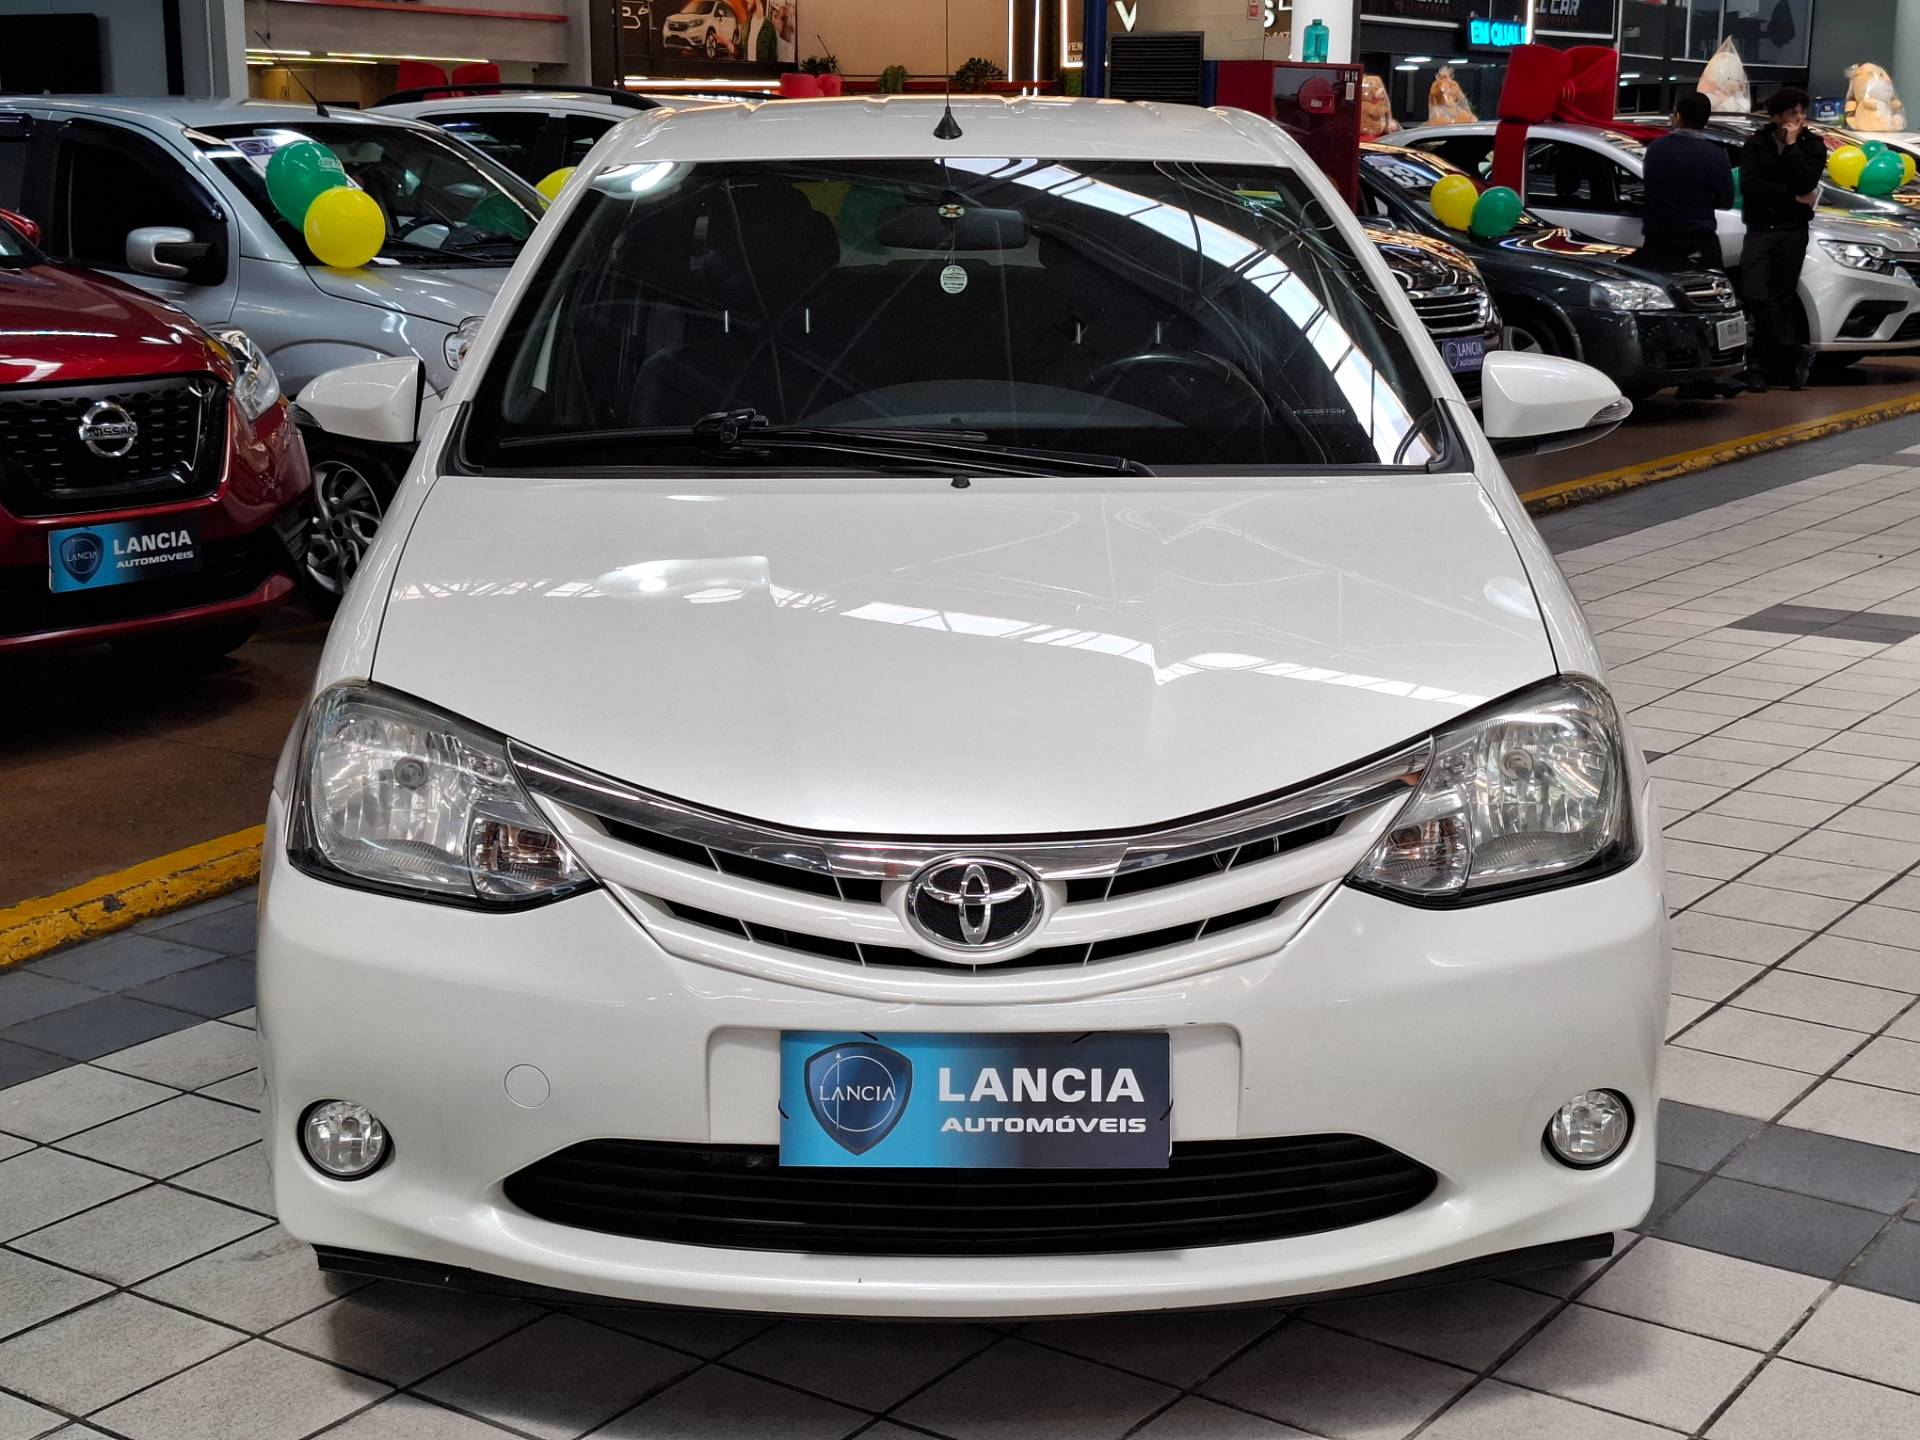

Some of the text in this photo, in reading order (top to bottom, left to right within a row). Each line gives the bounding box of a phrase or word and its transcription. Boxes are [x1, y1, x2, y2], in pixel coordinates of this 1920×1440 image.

[1550, 0, 1580, 16] CAR
[1471, 21, 1491, 45] EM
[86, 426, 137, 438] NISSAN
[114, 530, 192, 555] LANCIA
[66, 551, 97, 562] LANCIA
[116, 550, 194, 569] AUTOMÓVEIS
[819, 1085, 896, 1101] LANCIA
[939, 1068, 1145, 1103] LANCIA
[941, 1114, 1147, 1134] AUTOMÓVEIS
